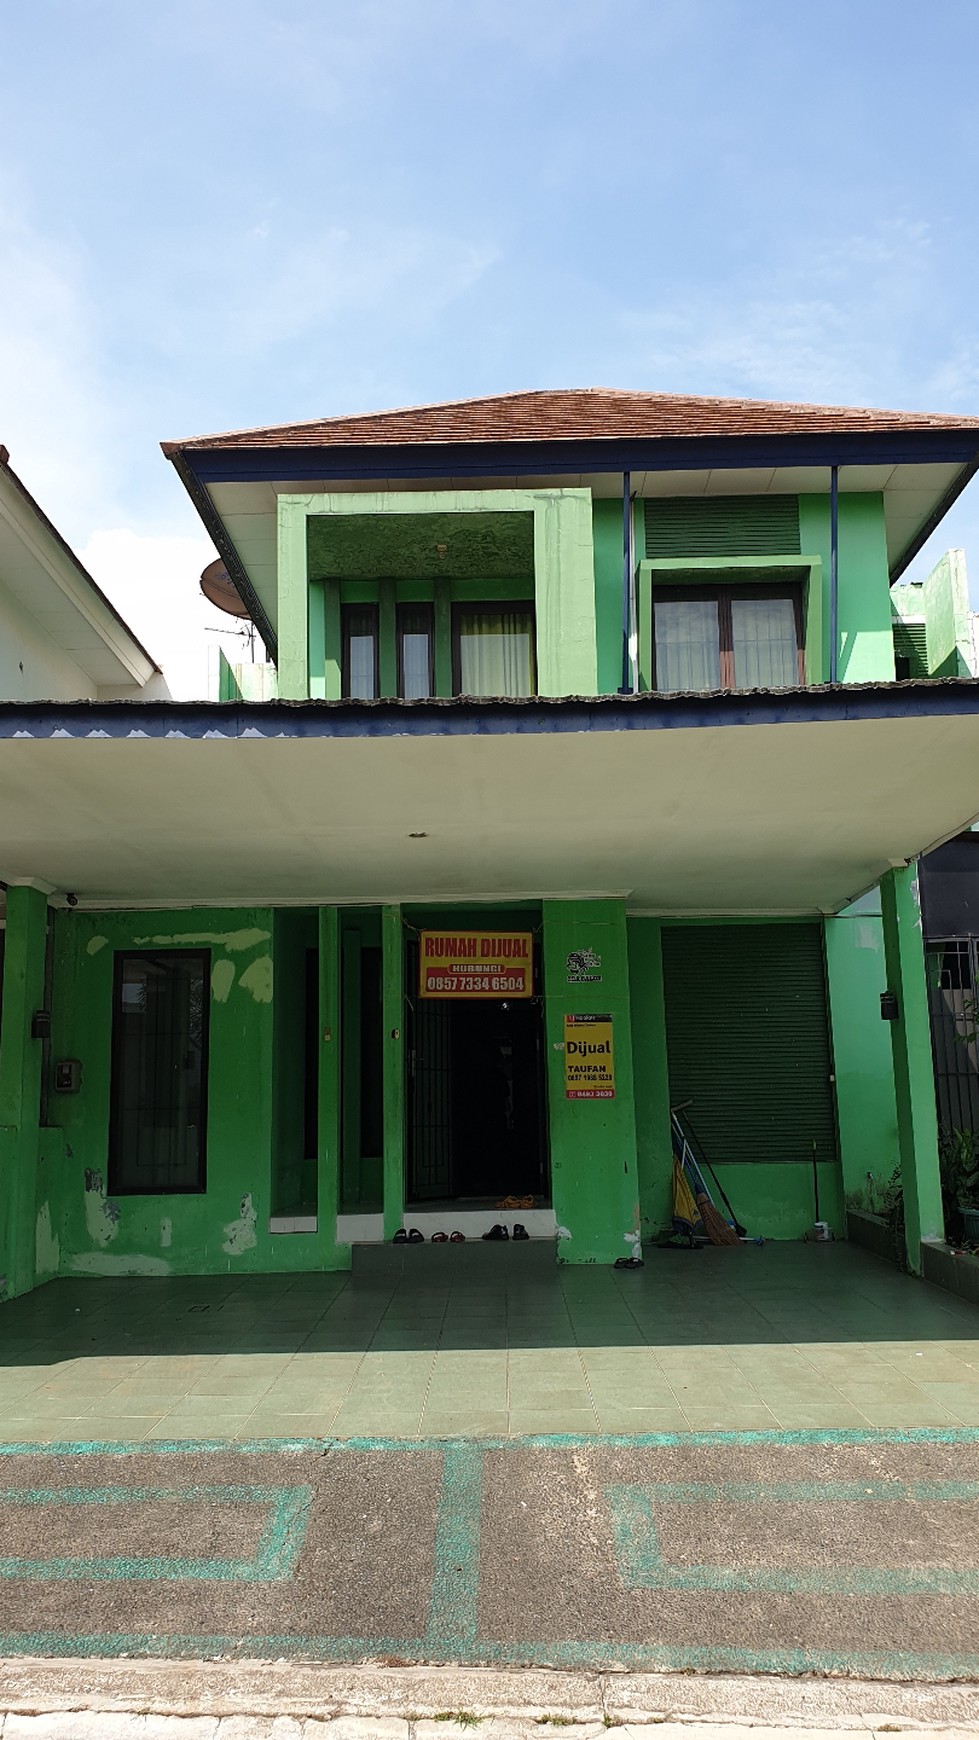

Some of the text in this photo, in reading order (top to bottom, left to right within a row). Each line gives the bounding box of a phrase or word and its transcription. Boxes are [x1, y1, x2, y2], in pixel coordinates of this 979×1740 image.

[425, 937, 528, 958] RUMAH DIJUAL
[452, 965, 501, 973] HUBUNGI
[427, 977, 524, 991] 0857 7334 6504
[567, 1040, 611, 1057] Dijual
[568, 1065, 606, 1073] TAUFAN
